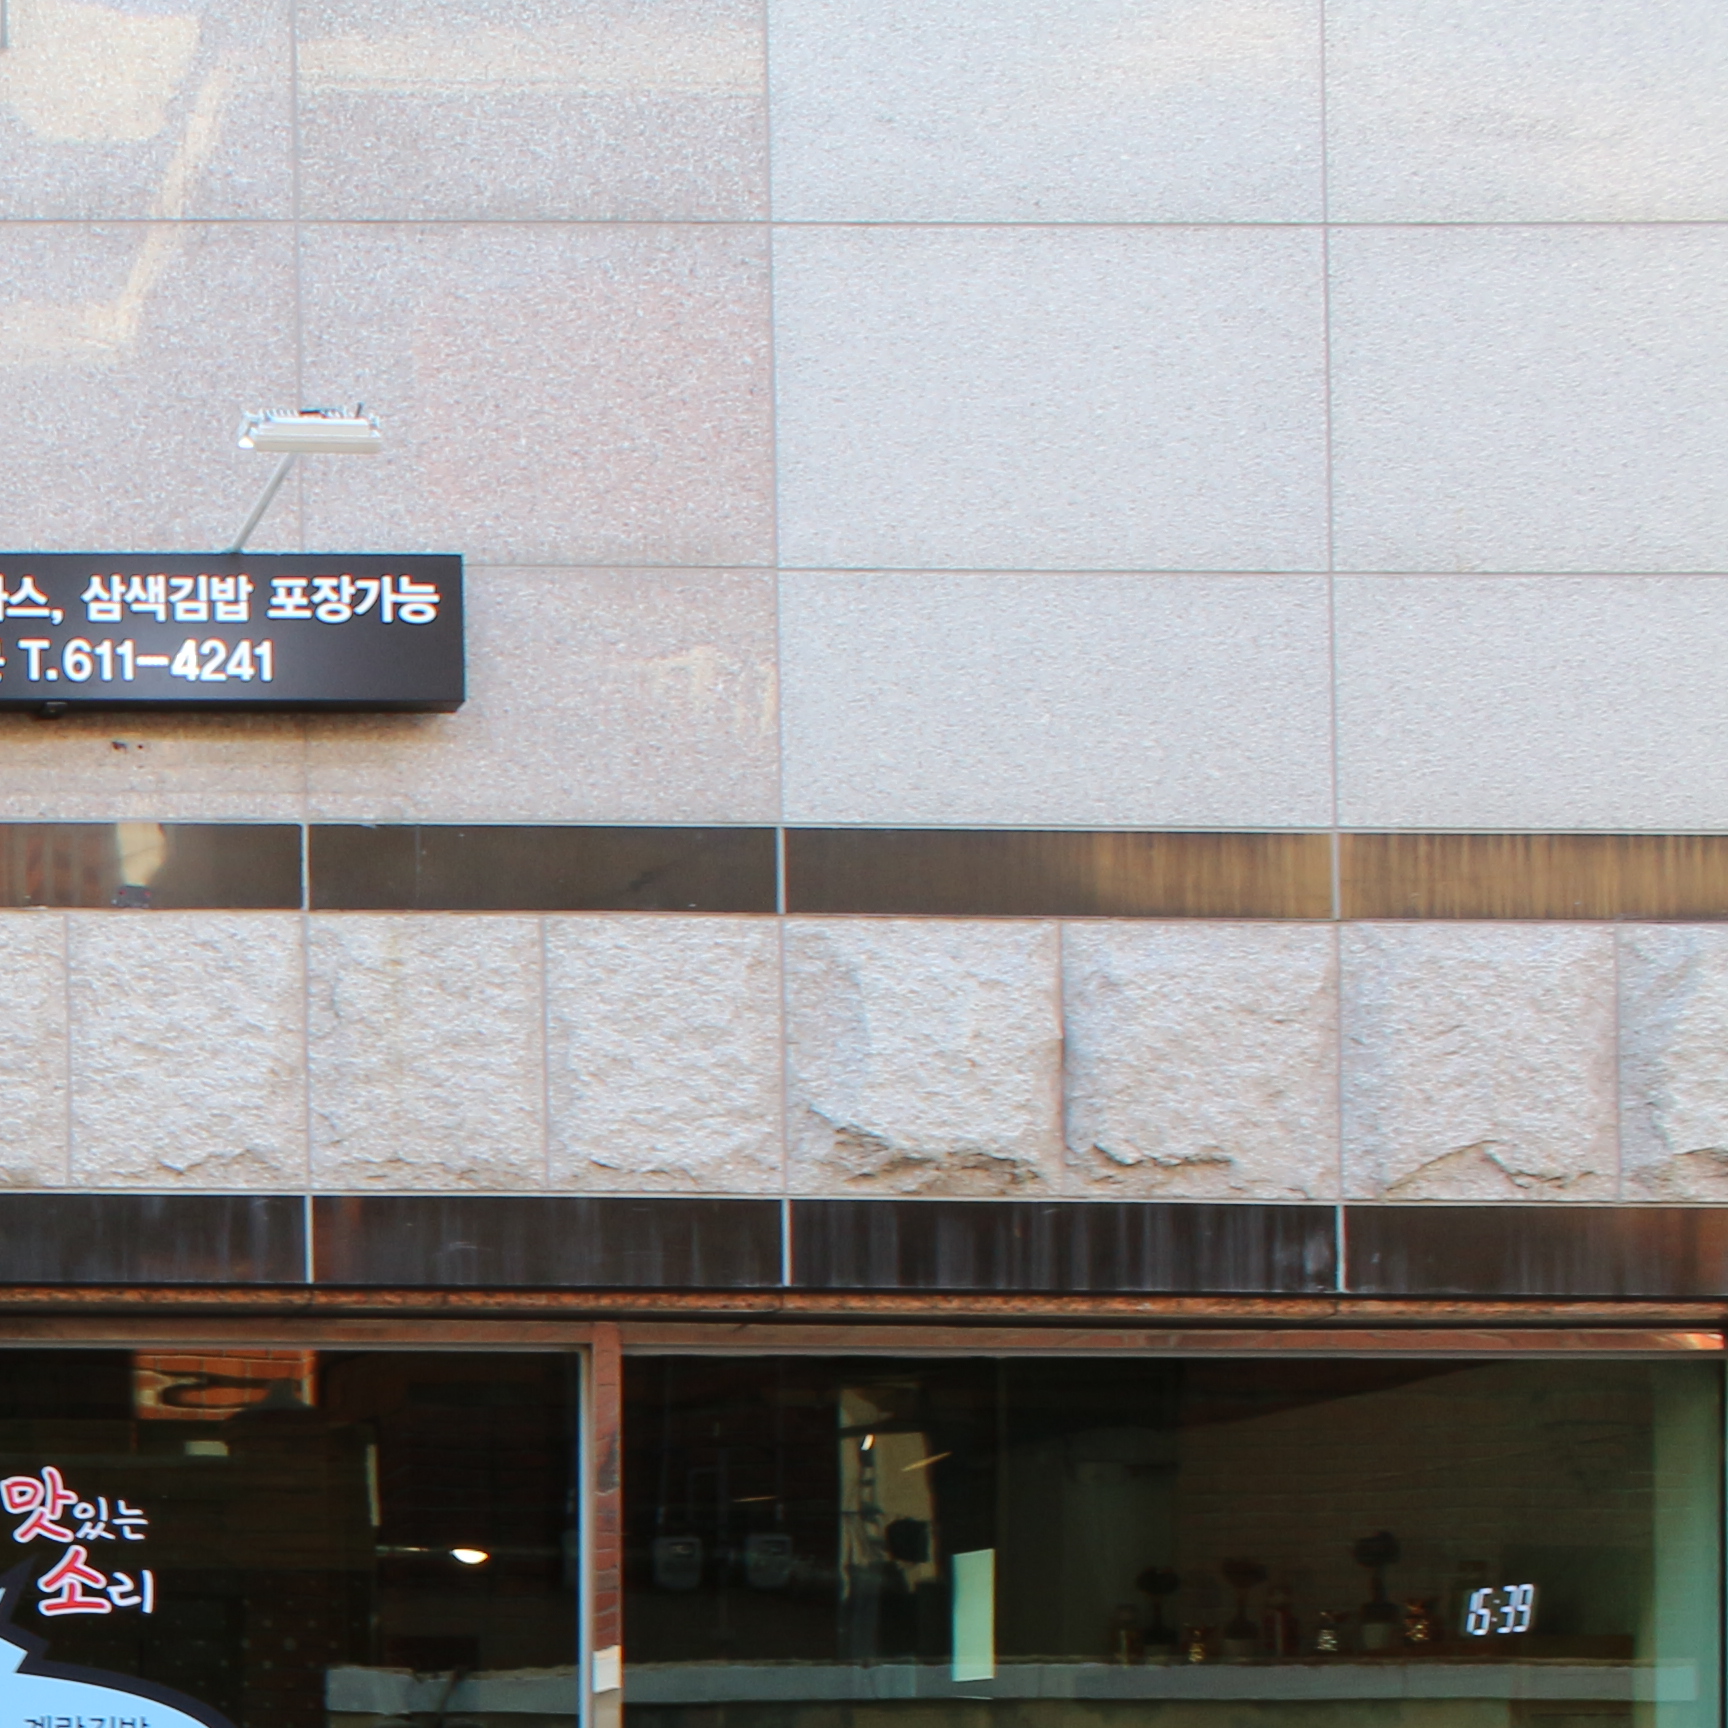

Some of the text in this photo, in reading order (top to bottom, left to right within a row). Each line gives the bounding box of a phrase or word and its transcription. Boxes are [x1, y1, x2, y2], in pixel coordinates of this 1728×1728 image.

[80, 572, 255, 628] 삼색김밥
[266, 572, 442, 628] 포장가능
[16, 636, 278, 686] T.611-4241
[0, 1465, 150, 1543] 맛있는
[37, 1545, 155, 1616] 소리
